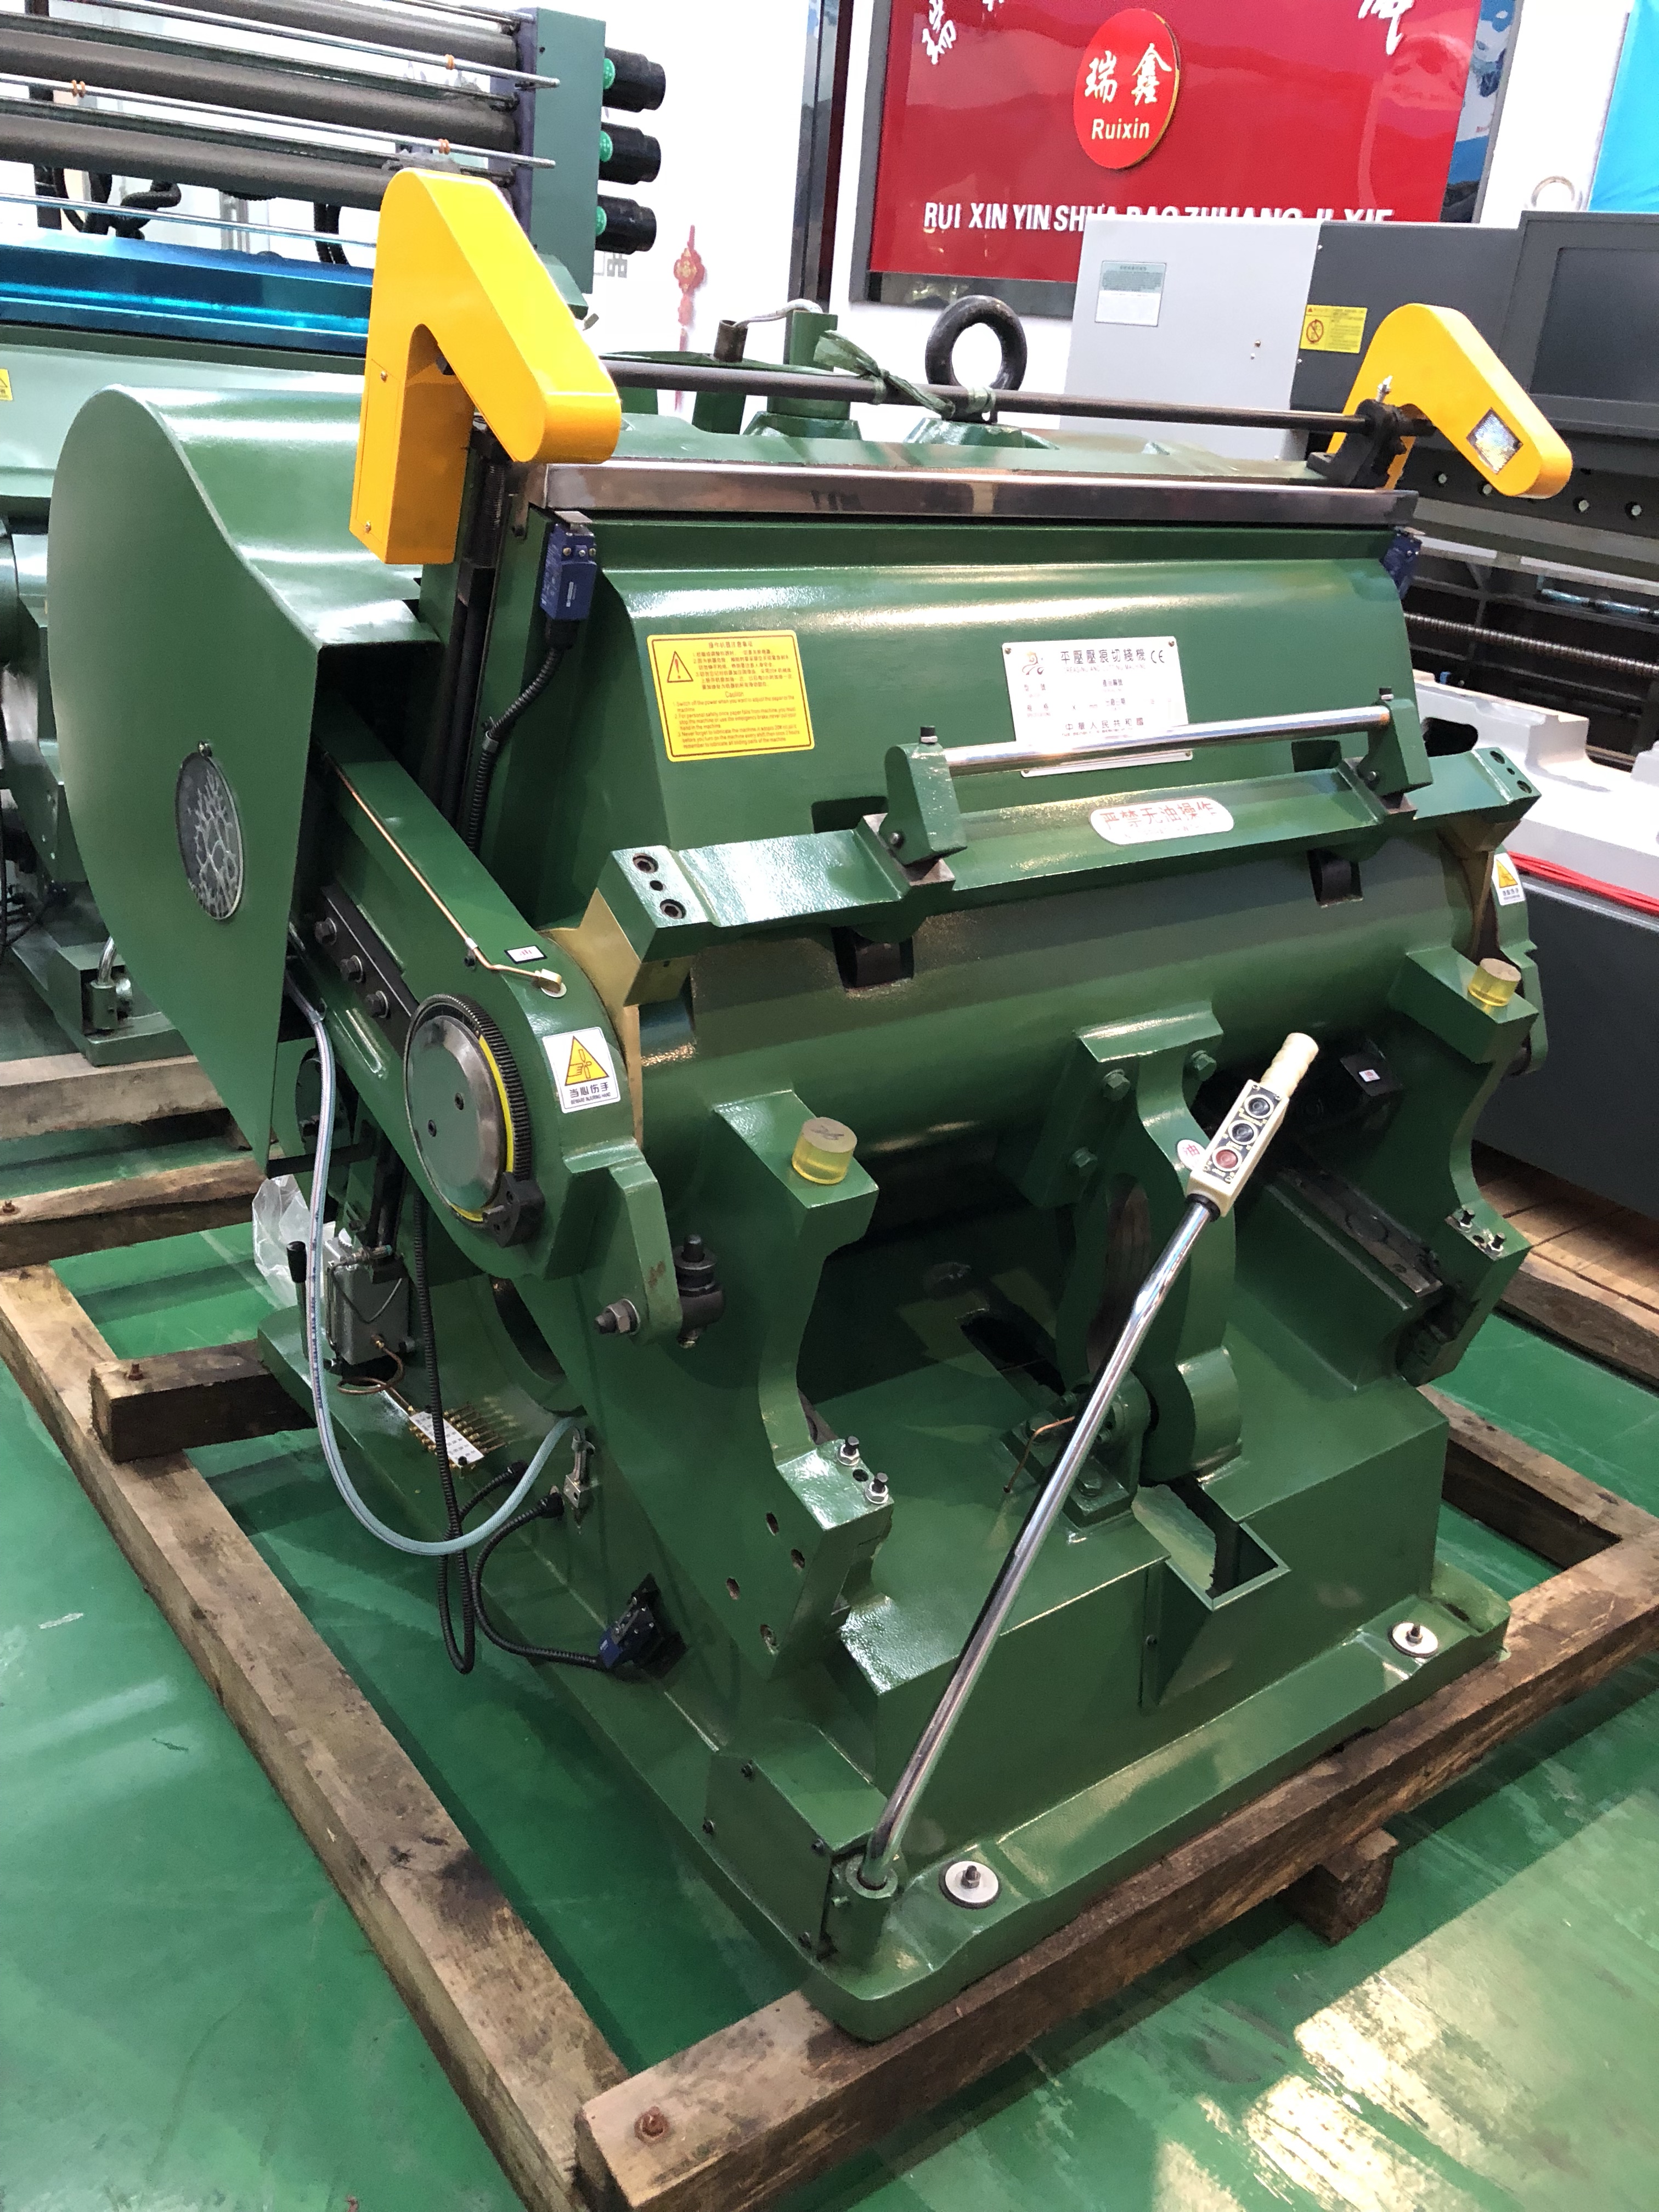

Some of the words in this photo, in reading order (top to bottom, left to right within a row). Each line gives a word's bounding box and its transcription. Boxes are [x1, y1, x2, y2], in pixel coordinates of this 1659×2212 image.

[1085, 43, 1172, 105] 瑞鑫
[1092, 117, 1150, 140] Ruixin
[924, 202, 962, 229] RUI
[969, 202, 1008, 229] XIN
[1013, 204, 1052, 230] YIN
[1099, 802, 1217, 830] 严禁无油操作
[569, 1082, 608, 1098] 当心伤手
[1182, 1144, 1200, 1157] 油
